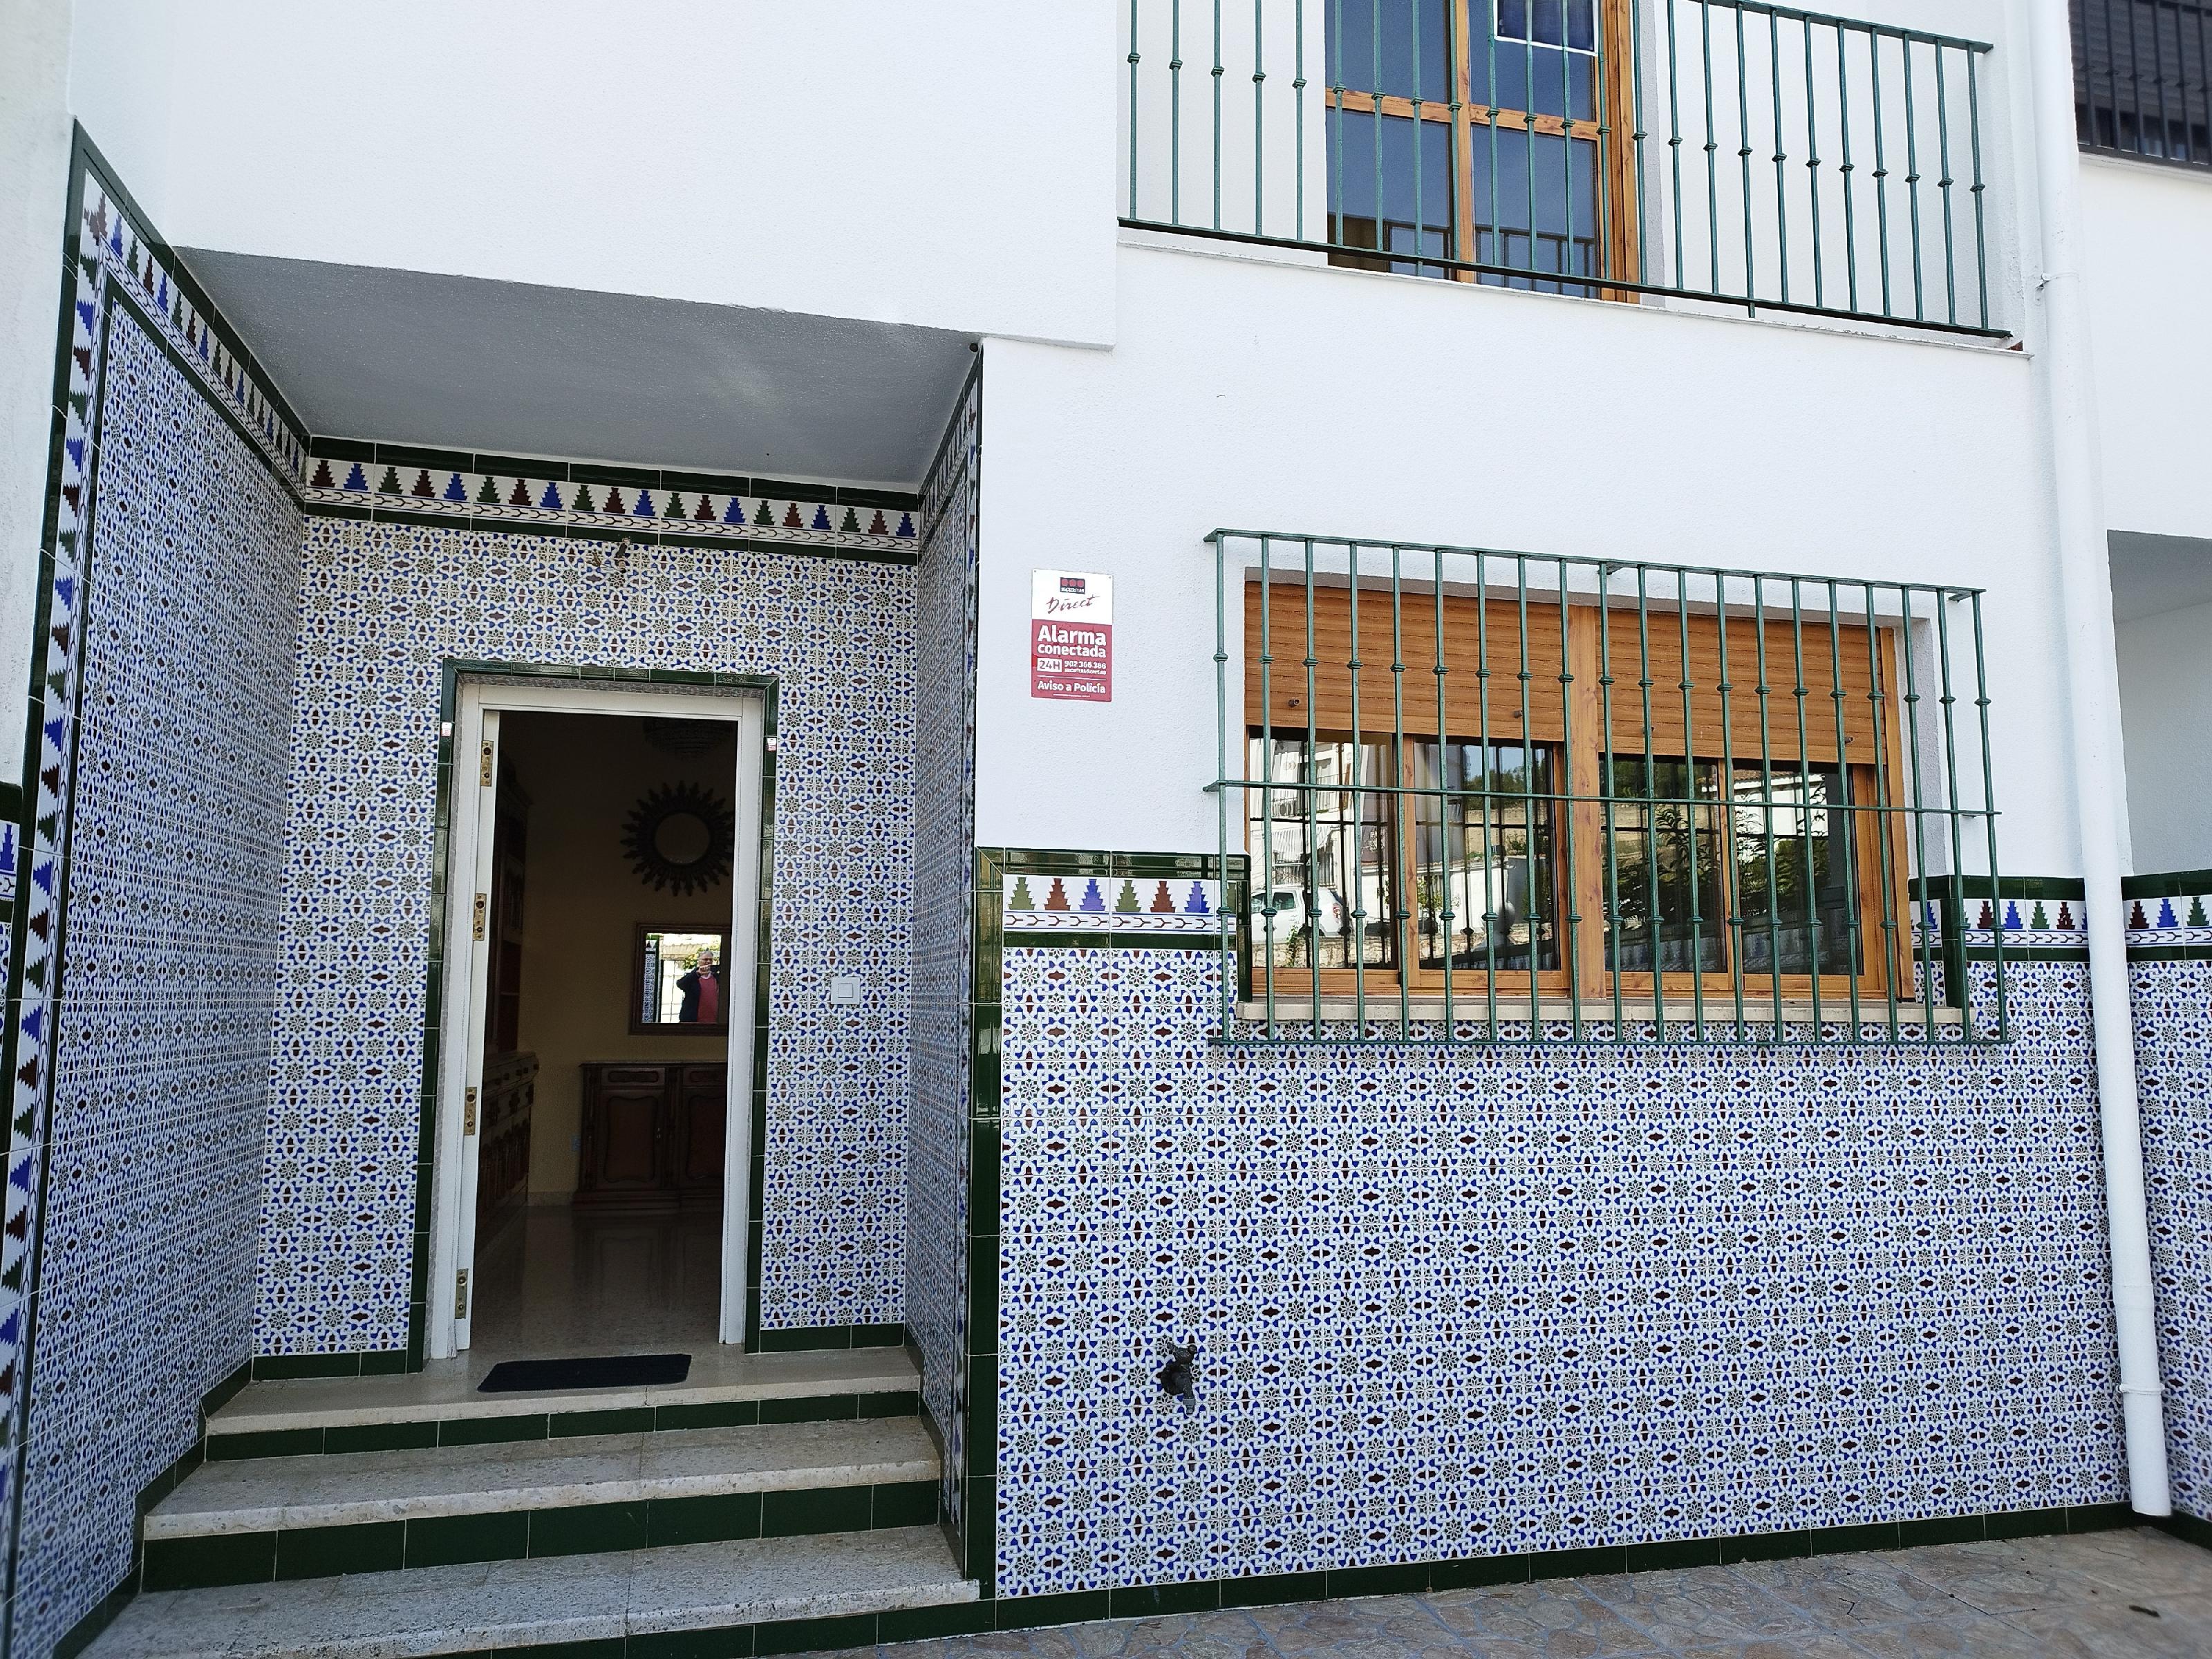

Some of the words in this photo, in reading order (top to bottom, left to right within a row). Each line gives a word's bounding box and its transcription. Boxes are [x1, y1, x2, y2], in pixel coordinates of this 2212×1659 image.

[1046, 594, 1100, 614] Direct
[1038, 624, 1107, 646] Alarma
[1038, 644, 1107, 658] conectada
[1039, 660, 1060, 670] 24H
[1037, 679, 1065, 691] Aviso
[1074, 682, 1106, 694] Policía
